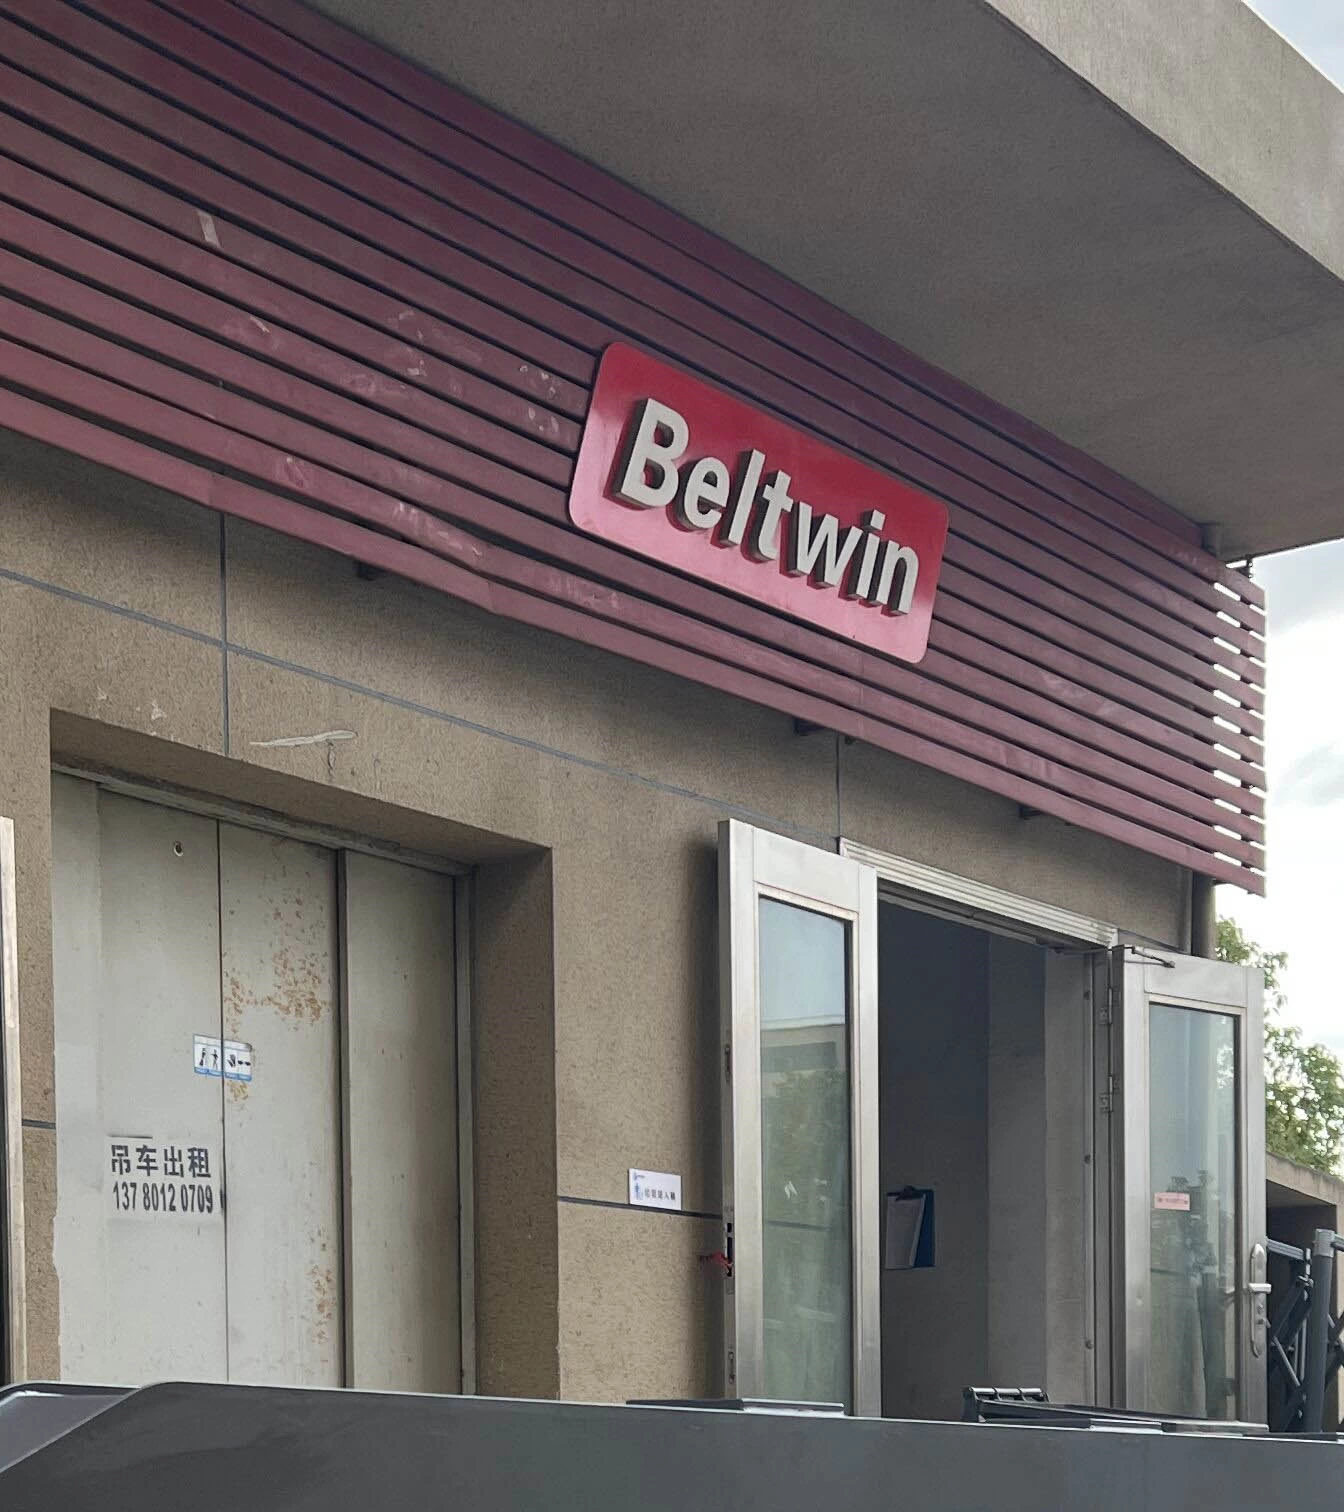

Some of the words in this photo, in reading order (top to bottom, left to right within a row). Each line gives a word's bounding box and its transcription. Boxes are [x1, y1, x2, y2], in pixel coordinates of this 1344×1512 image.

[616, 397, 920, 616] Beltwin
[111, 1144, 211, 1178] 吊车出租
